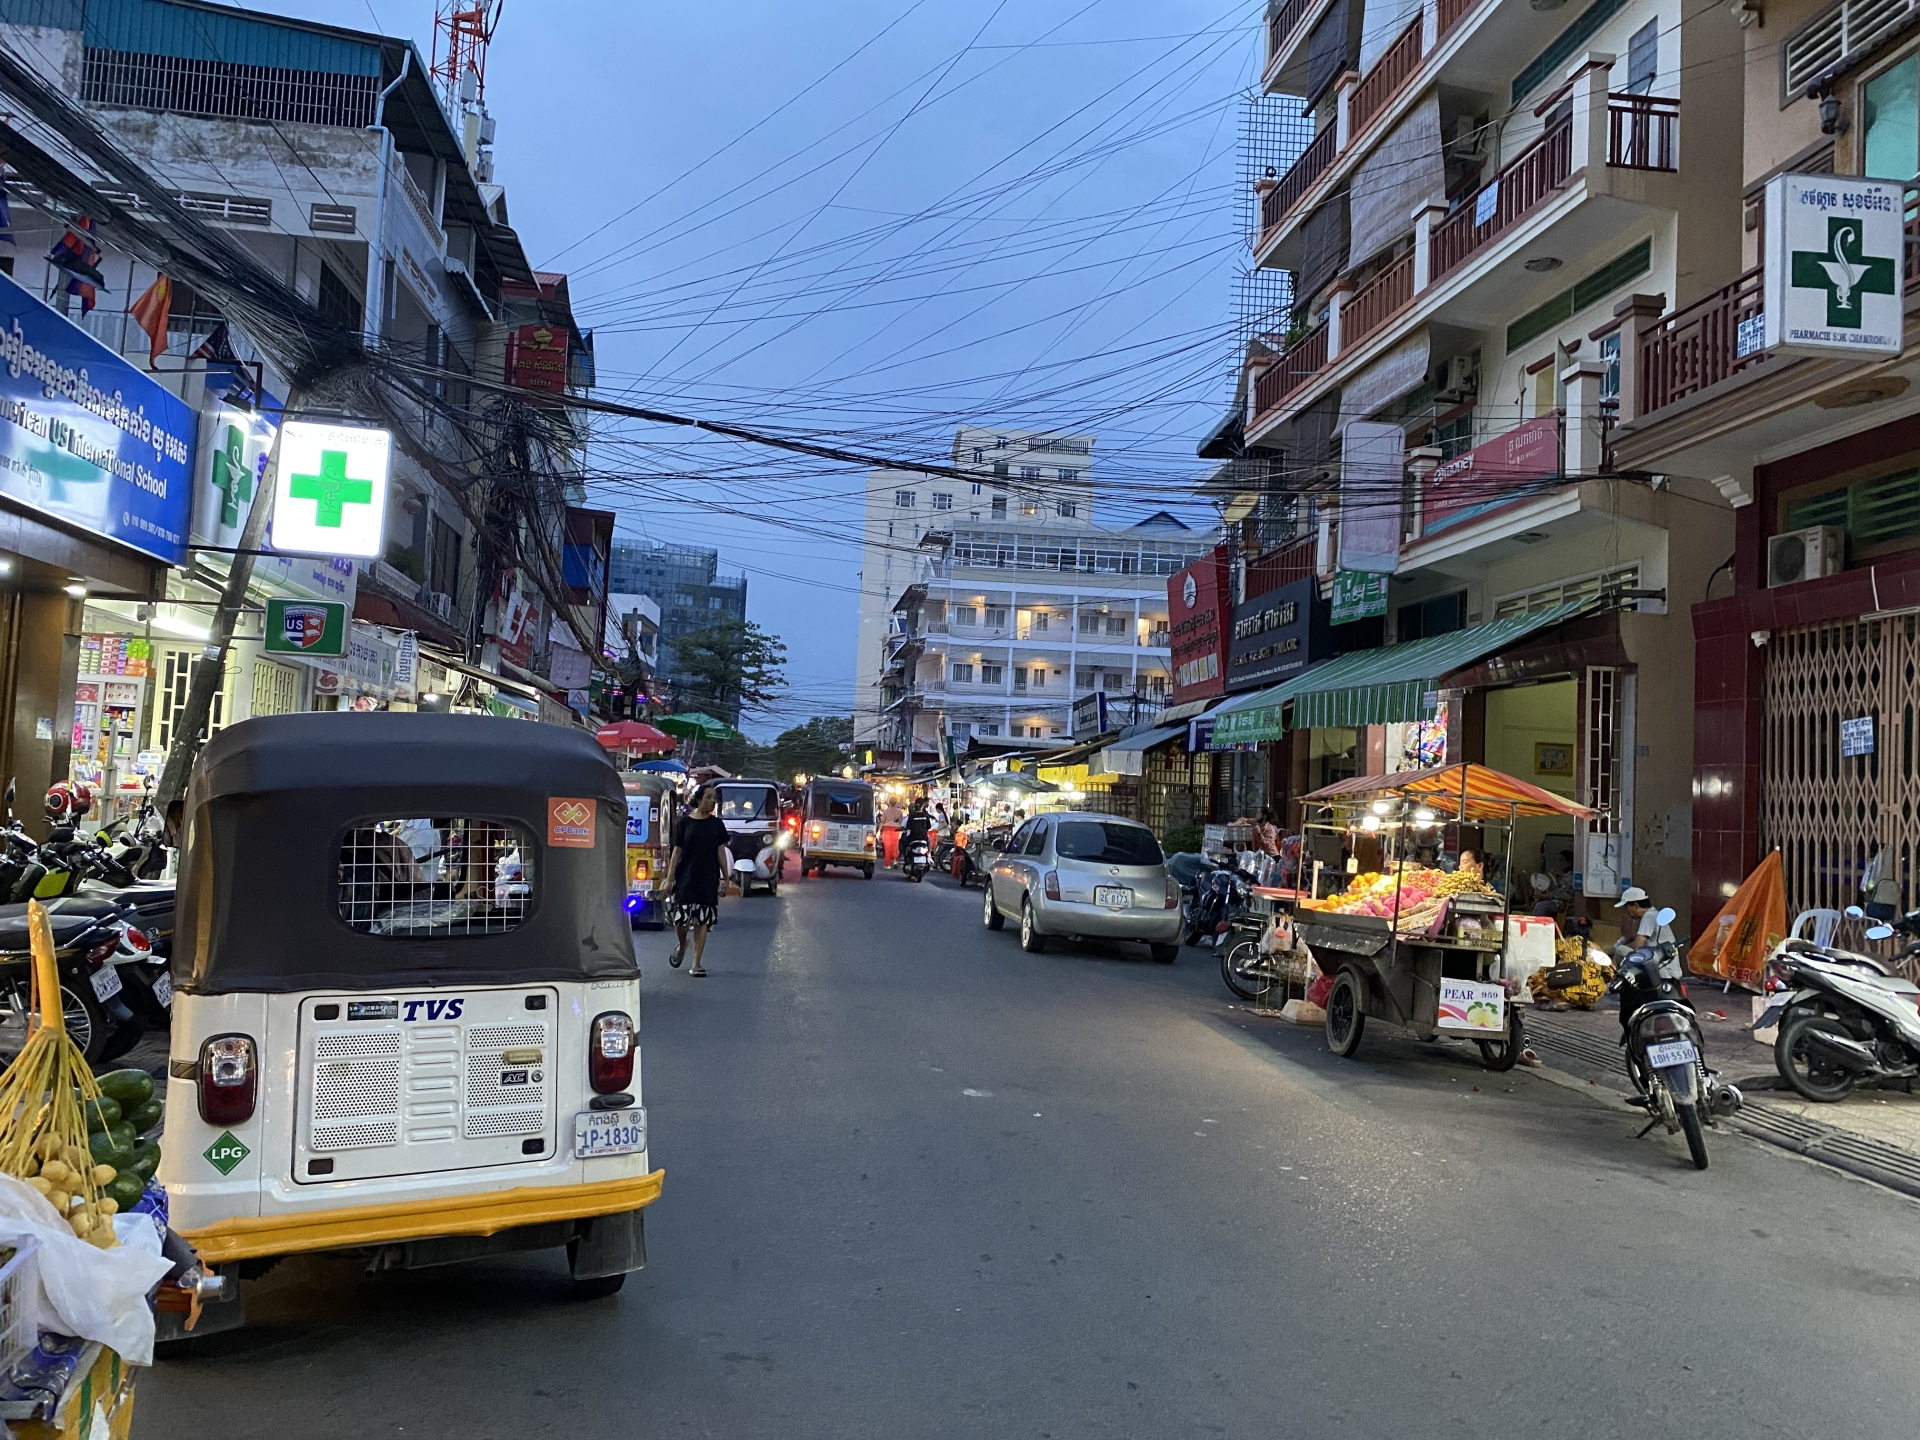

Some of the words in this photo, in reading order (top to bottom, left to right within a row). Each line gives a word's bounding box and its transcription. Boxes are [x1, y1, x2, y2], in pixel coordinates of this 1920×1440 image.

[1790, 329, 1831, 341] PHARMACIE
[0, 399, 48, 438] merican
[51, 417, 69, 448] US
[68, 429, 134, 484] International
[137, 464, 168, 499] School
[286, 619, 304, 630] US
[554, 826, 589, 835] CPBank
[1444, 988, 1474, 1000] PEAR
[1481, 991, 1498, 999] 959
[403, 998, 465, 1021] TVS
[503, 1072, 526, 1083] AC
[582, 1126, 639, 1149] 1P-1830
[211, 1147, 242, 1160] LPG
